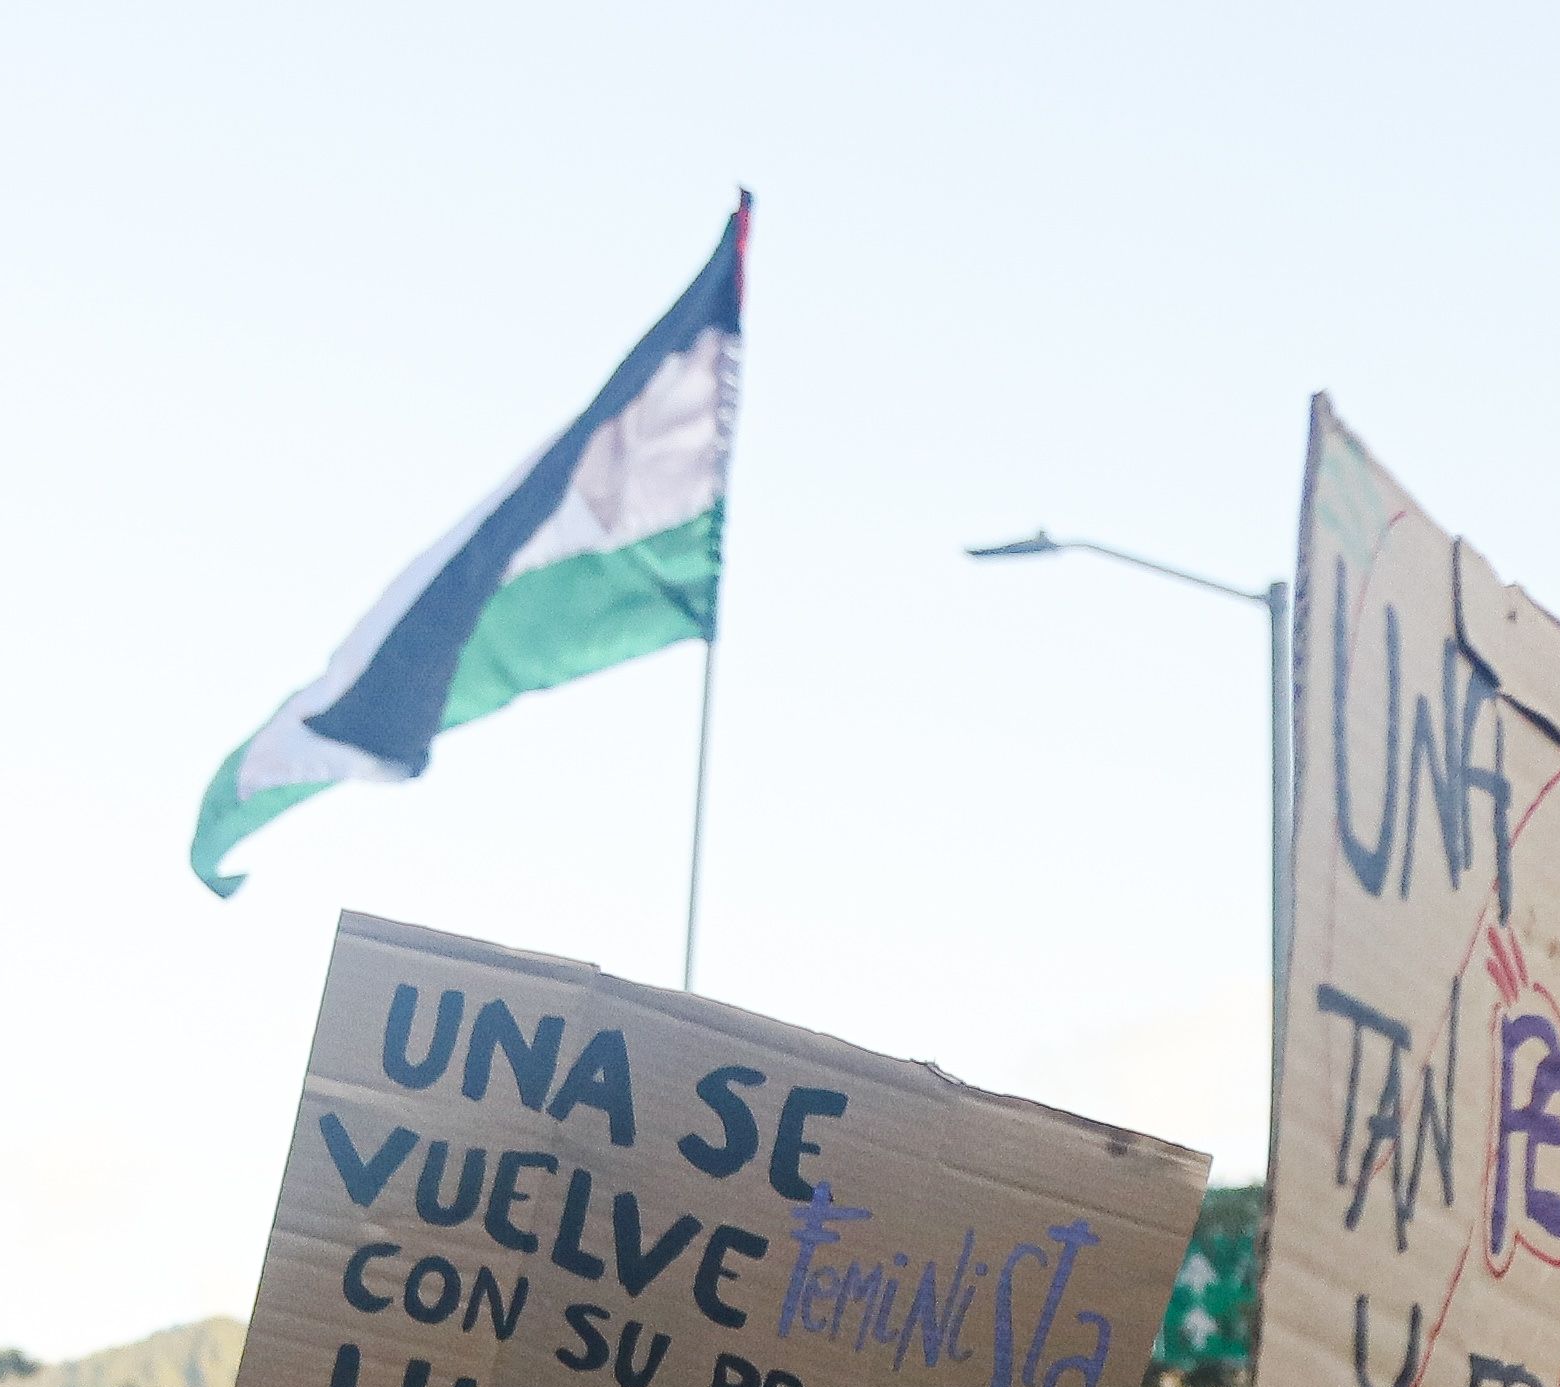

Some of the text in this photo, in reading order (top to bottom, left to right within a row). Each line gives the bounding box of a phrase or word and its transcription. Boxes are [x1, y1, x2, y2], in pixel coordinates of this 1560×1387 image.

[1332, 556, 1512, 925] UNA
[383, 983, 849, 1205] UNA SE
[1316, 975, 1461, 1252] TAN
[319, 1112, 770, 1331] VUELVE
[341, 1239, 531, 1343] CON
